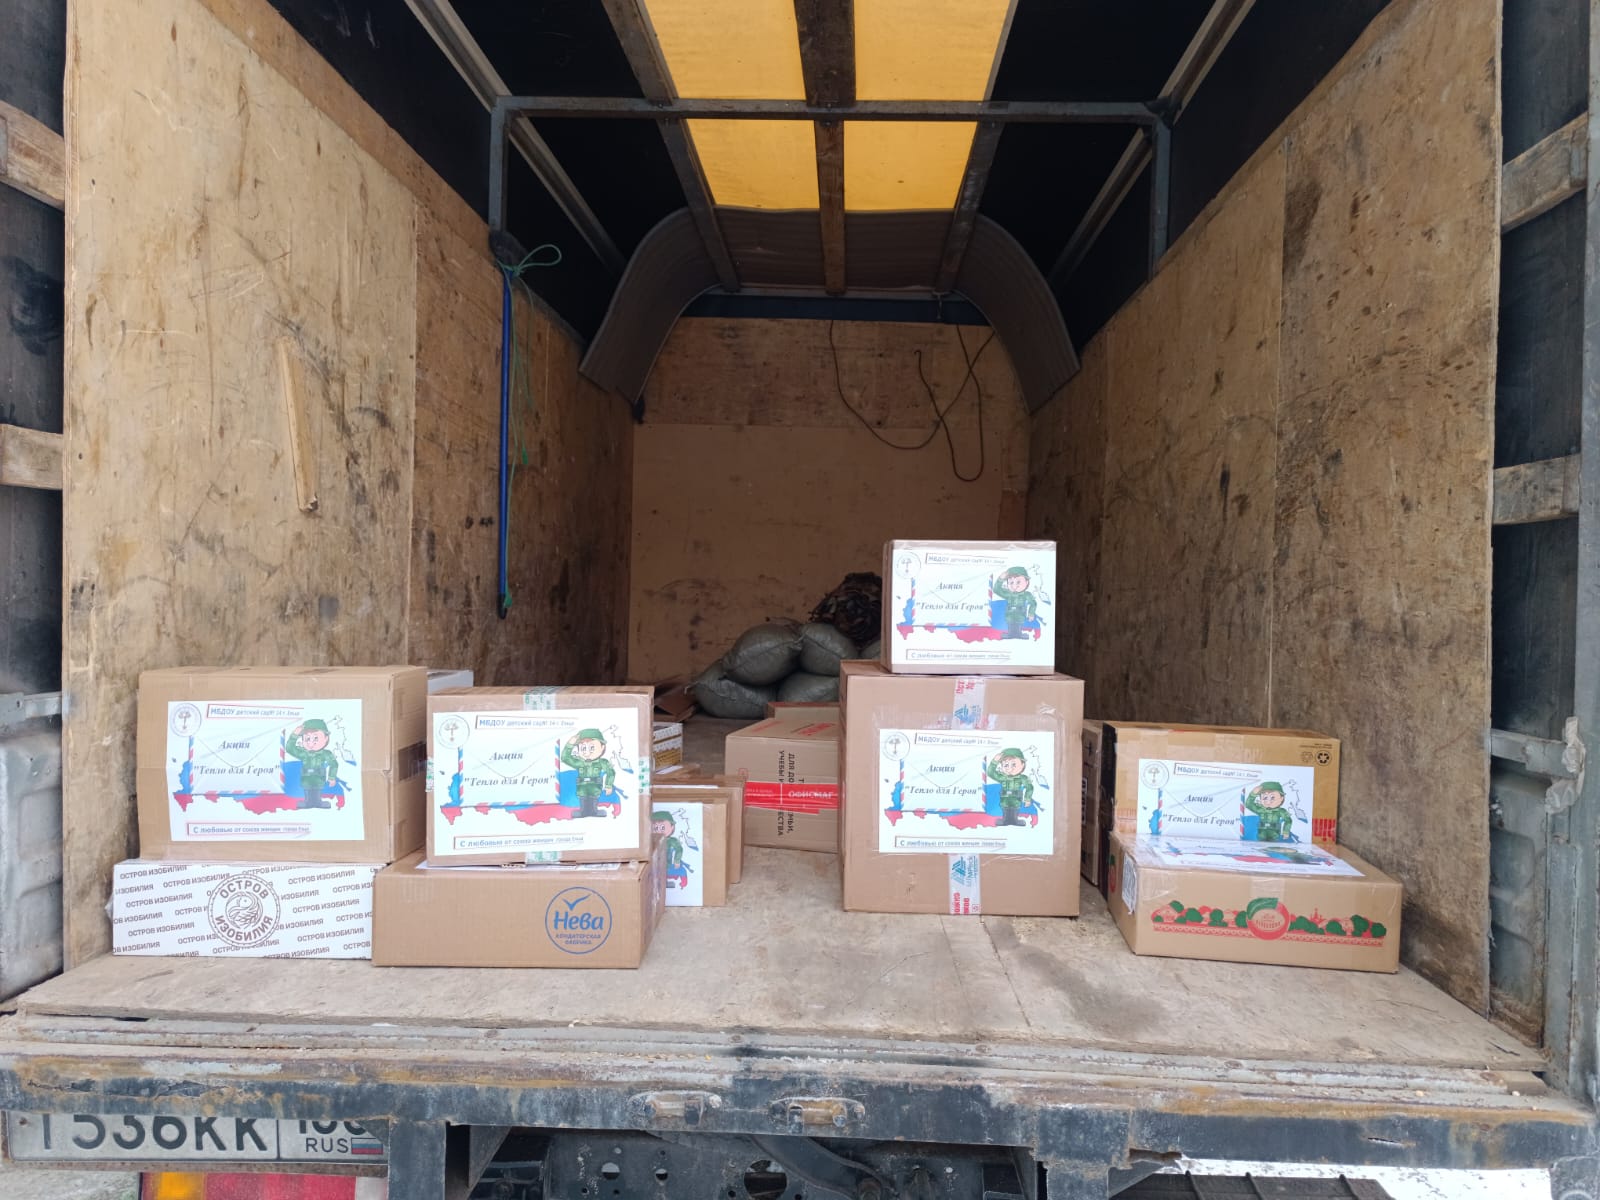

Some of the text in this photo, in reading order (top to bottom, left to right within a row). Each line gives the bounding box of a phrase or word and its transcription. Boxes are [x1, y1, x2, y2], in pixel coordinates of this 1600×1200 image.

[936, 582, 963, 590] Акция
[916, 602, 988, 611] "Тепло для Героя"
[218, 740, 250, 750] Акция
[489, 752, 523, 762] Акция
[195, 765, 280, 775] "Тепло для Героя"
[927, 765, 955, 773] Акция
[464, 775, 555, 787] "Тепло для Героя"
[905, 786, 981, 796] "Тепло для Героя"
[1184, 794, 1213, 803] Акция
[1163, 814, 1240, 825] "Тепло для Героя"
[468, 839, 502, 847] любовью
[120, 865, 187, 879] ОСТРОВ ИЗОБИЛИЯ
[288, 870, 355, 885] ОСТРОВ ИЗОБИЛИЯ
[163, 879, 191, 888] ОСТРОВ
[333, 883, 360, 893] ОСТРОВ
[219, 879, 269, 899] ОСТРОВ
[281, 889, 319, 901] ИЗОБИЛИЯ
[126, 893, 192, 908] ОСТРОВ ИЗОБИЛИЯ
[293, 899, 360, 913] ОСТРОВ ИЗОБИЛИЯ
[175, 907, 202, 916] ОСТРОВ
[124, 912, 163, 923] ИЗОБИЛИЯ
[336, 912, 363, 922] ОСТРОВ
[554, 911, 604, 930] Нева
[215, 915, 273, 941] ИЗОБИЛИЯ
[286, 919, 323, 929] ИЗОБИЛИЯ
[128, 923, 194, 937] ОСТРОВ ИЗОБИЛИЯ
[297, 928, 365, 942] ОСТРОВ ИЗОБИЛИЯ
[178, 935, 205, 944] ОСТРОВ
[123, 942, 160, 952] ИЗОБИЛИЯ
[344, 941, 371, 950] ОСТРОВ
[306, 1138, 348, 1153] RUS
